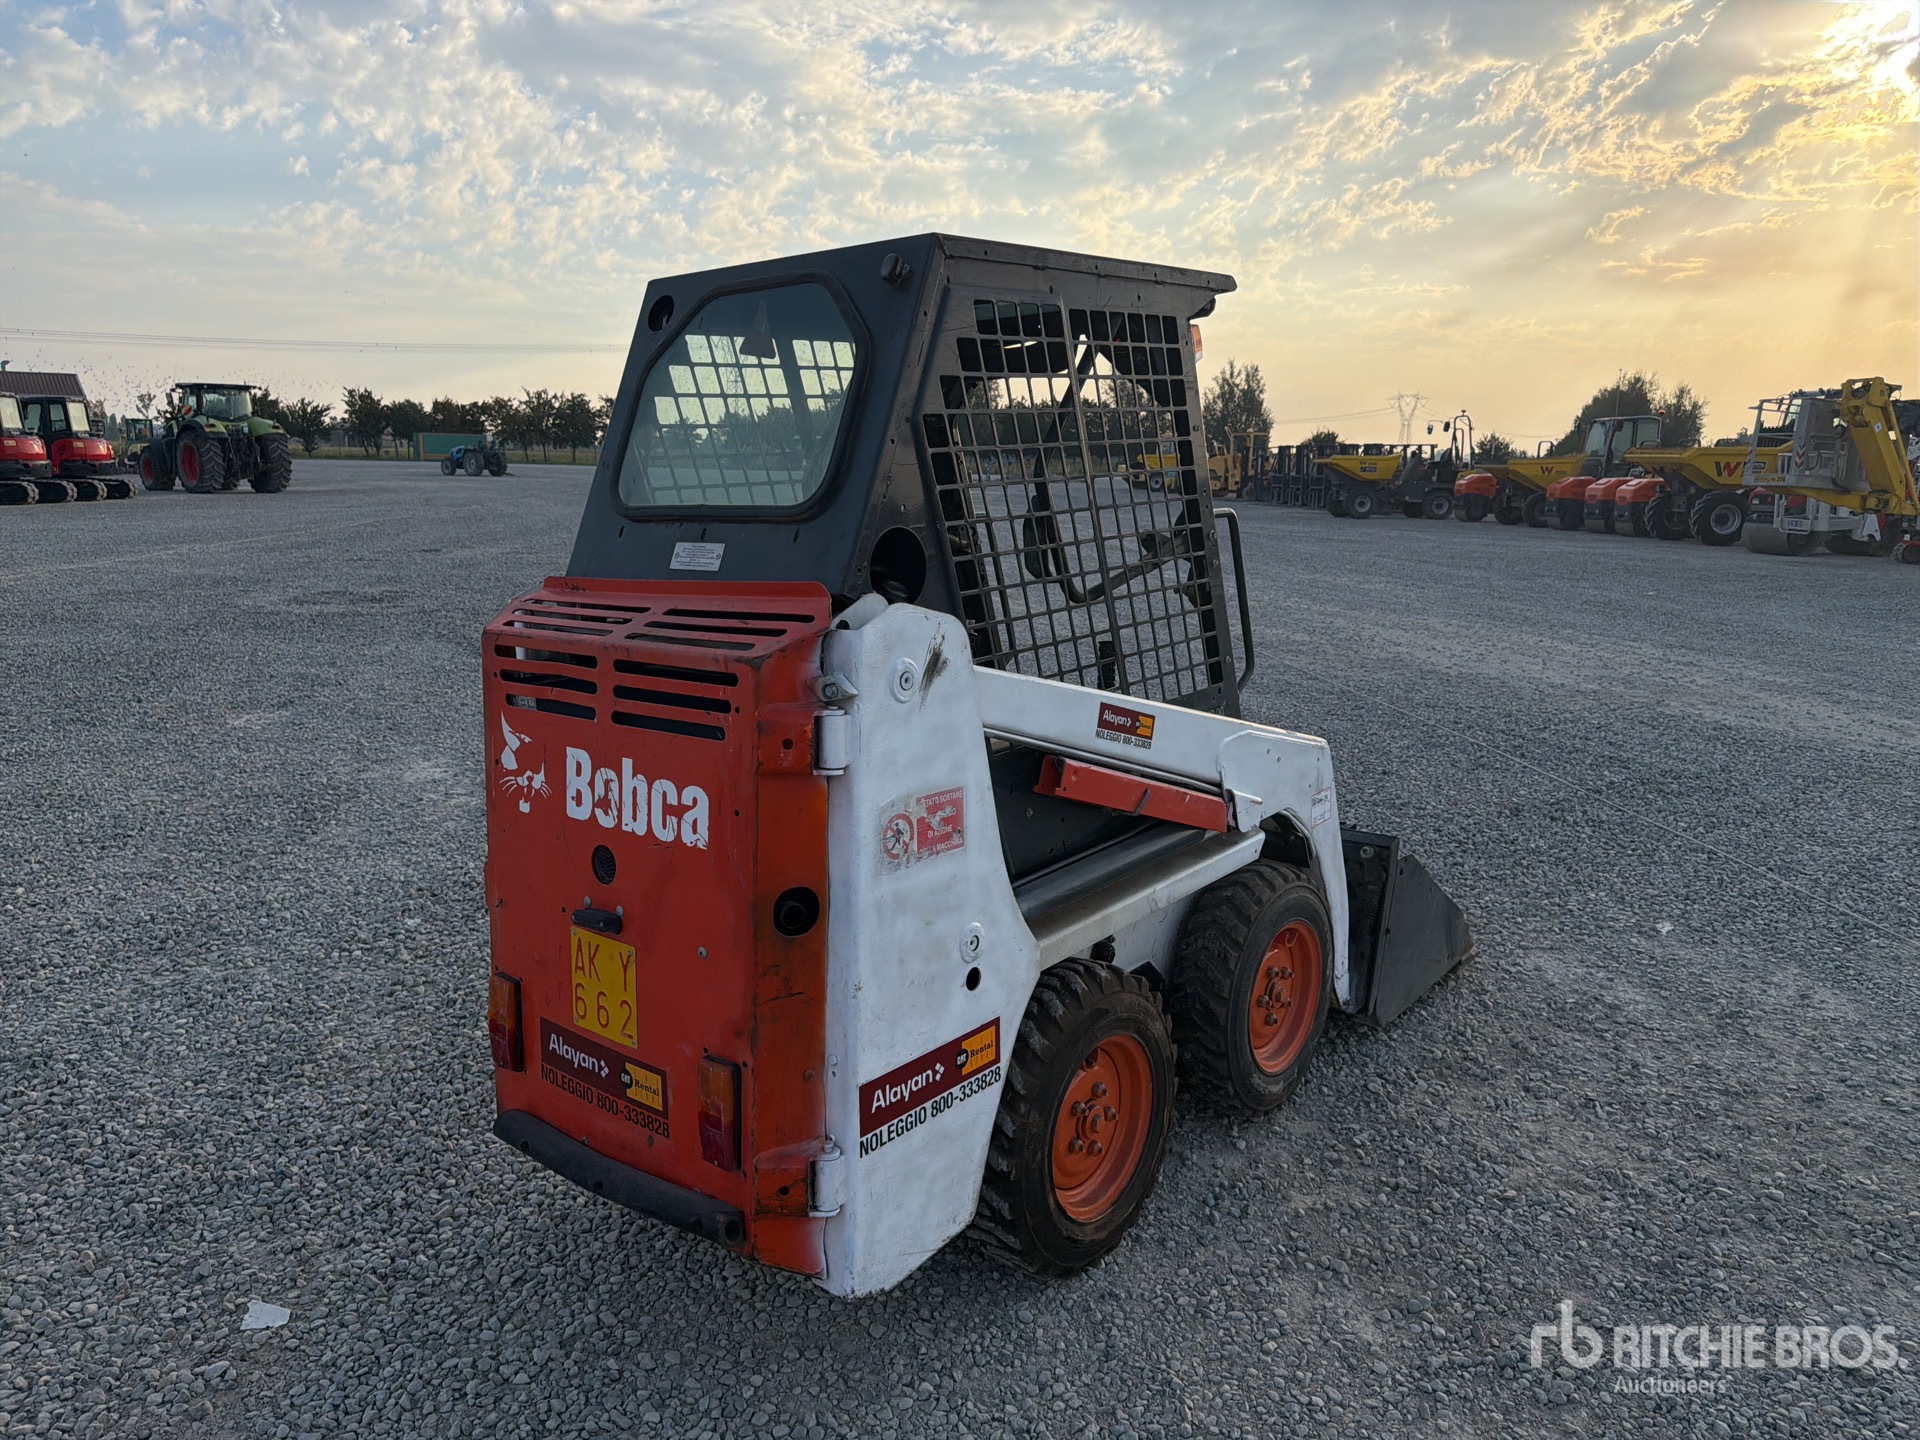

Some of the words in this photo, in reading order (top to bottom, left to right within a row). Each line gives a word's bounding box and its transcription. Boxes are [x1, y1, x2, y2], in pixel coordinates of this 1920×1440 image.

[1103, 709, 1127, 726] Alayan
[1095, 729, 1121, 743] NOLEGGIO
[940, 790, 963, 803] SOSTARE
[574, 936, 601, 982] AK
[549, 1033, 599, 1073] Alayan
[969, 1040, 993, 1059] Rental
[956, 1053, 967, 1065] CAT
[620, 1072, 631, 1084] CAT
[634, 1079, 660, 1097] Rental
[871, 1069, 933, 1114] Alayan
[541, 1064, 594, 1104] NOLEGGIO
[597, 1093, 670, 1139] 800-333828
[859, 1106, 927, 1158] NOLEGGIO
[930, 1066, 1001, 1118] 800-333828
